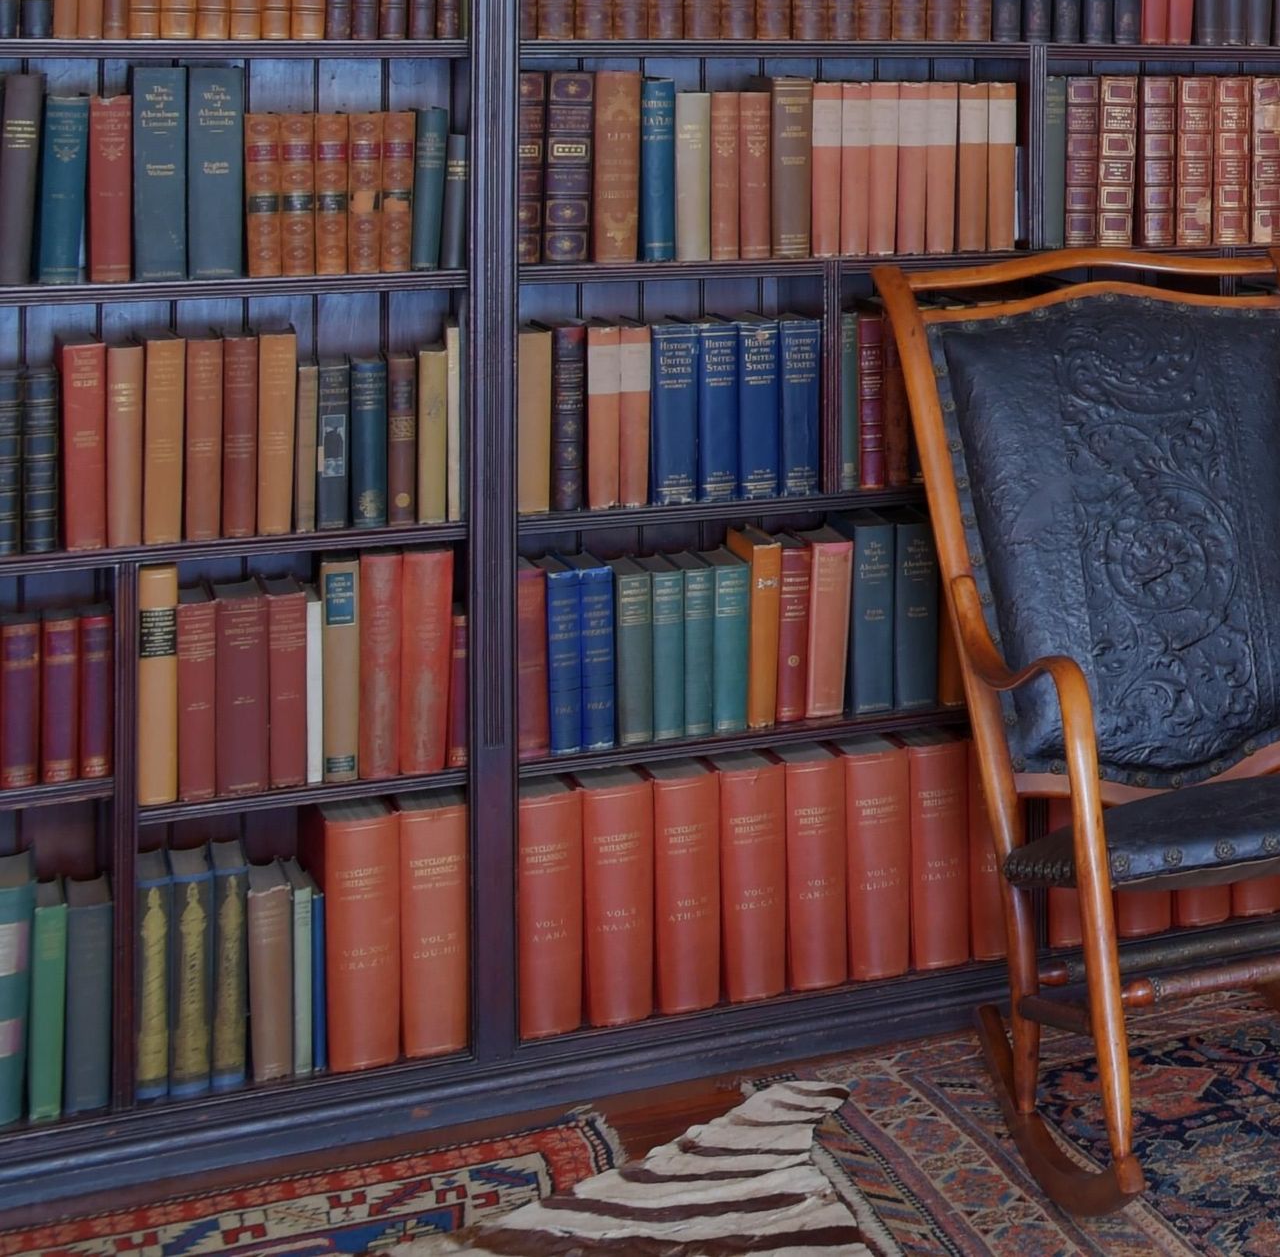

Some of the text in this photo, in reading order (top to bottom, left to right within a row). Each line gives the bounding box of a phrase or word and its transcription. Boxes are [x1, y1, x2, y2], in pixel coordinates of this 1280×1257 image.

[705, 354, 736, 363] UNITED
[744, 352, 775, 362] UNITED
[785, 351, 817, 360] UNITED
[659, 356, 693, 366] UNITED
[785, 360, 817, 369] STATES
[660, 366, 692, 375] STATES
[706, 363, 736, 373] STATES
[744, 362, 775, 372] STATES
